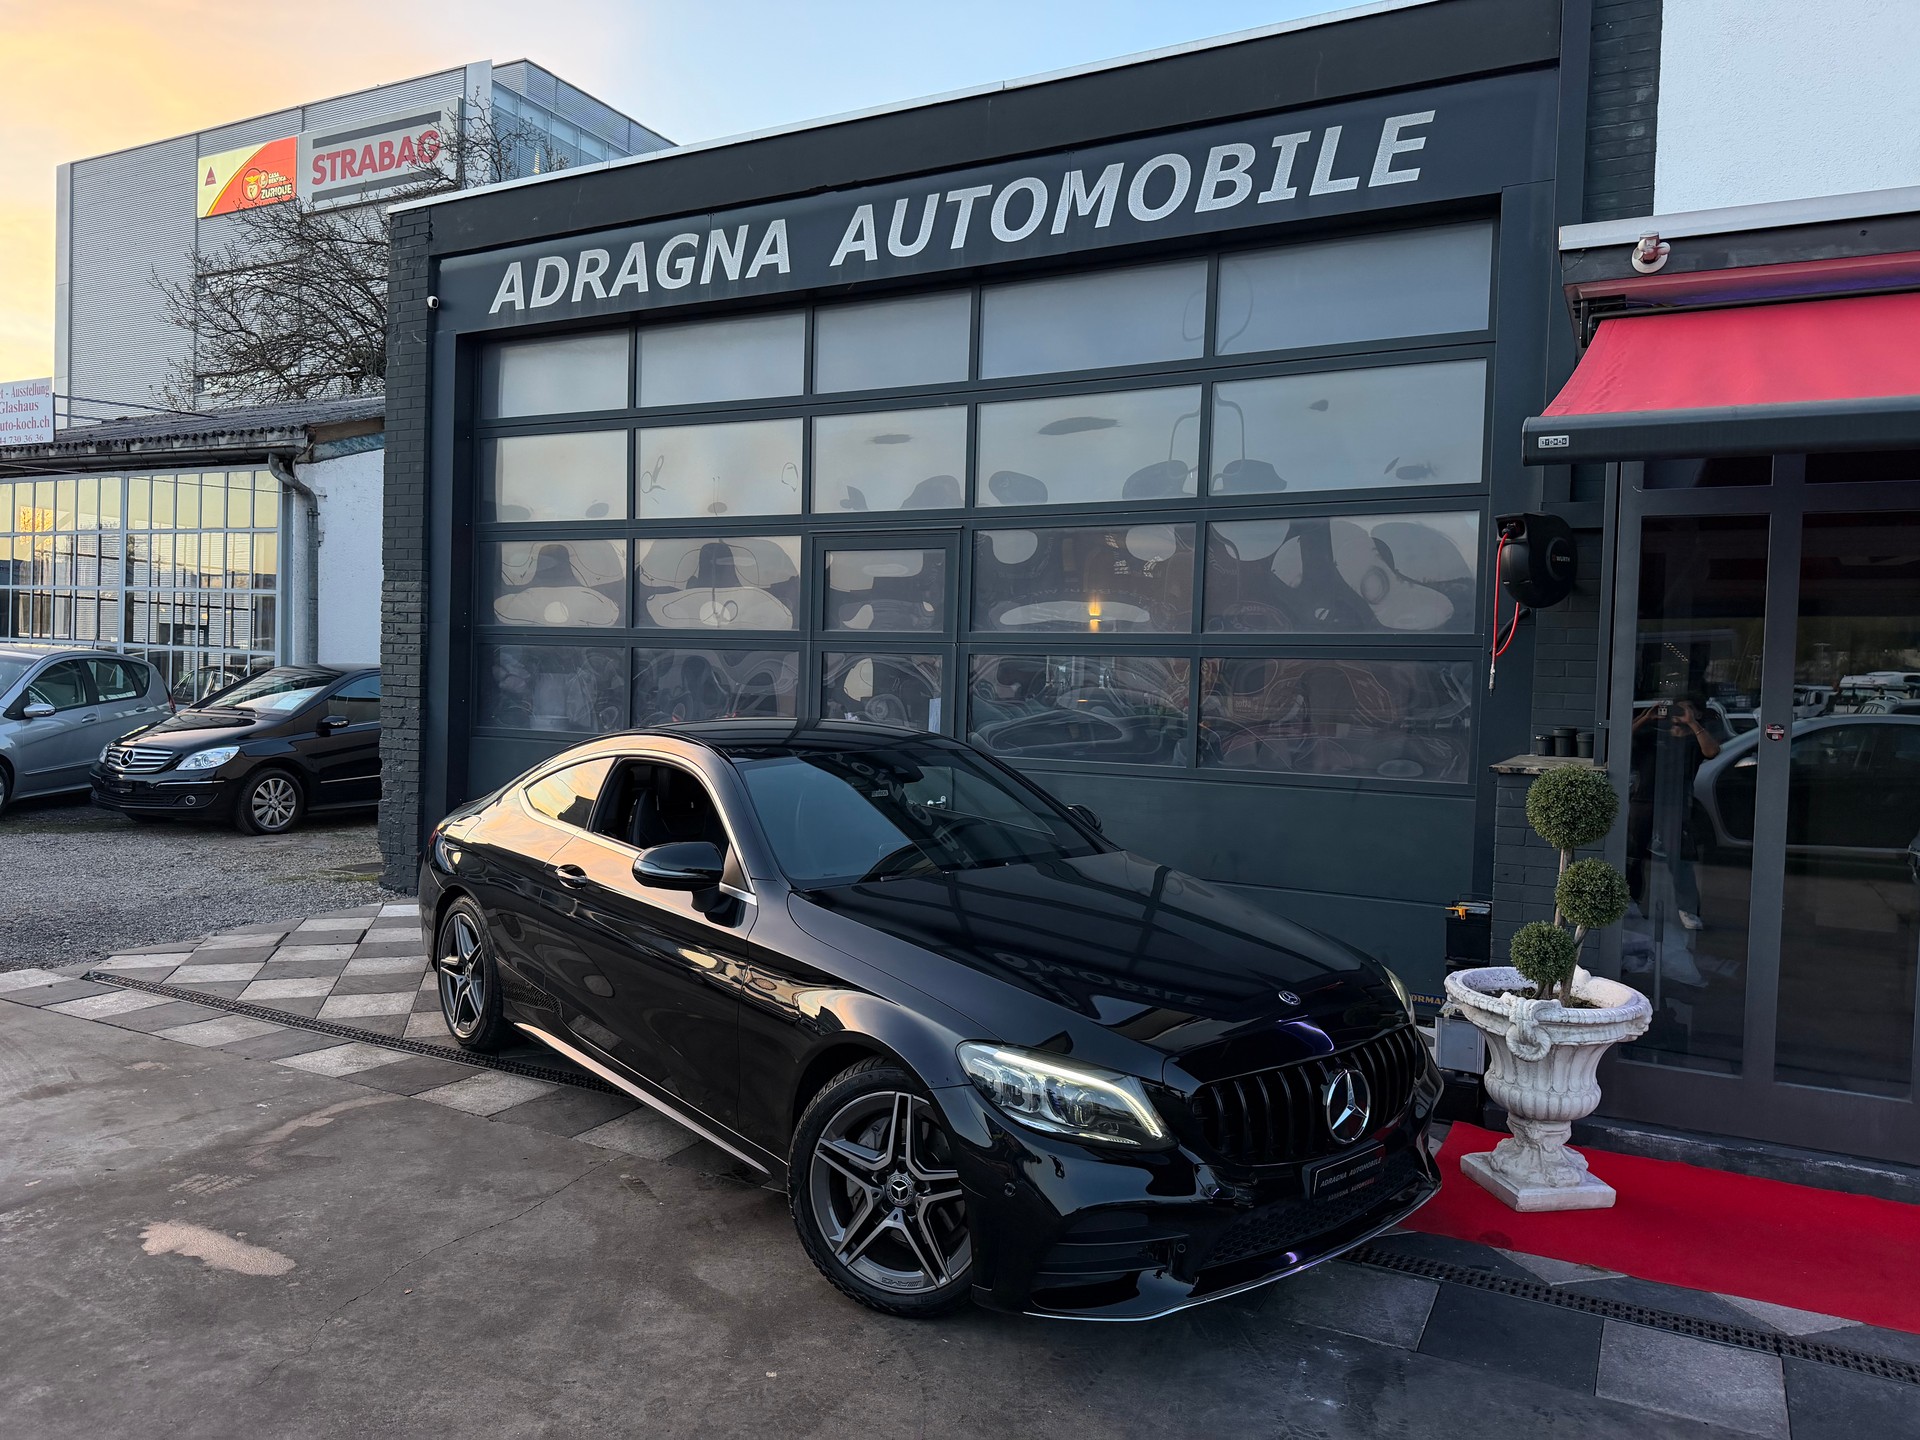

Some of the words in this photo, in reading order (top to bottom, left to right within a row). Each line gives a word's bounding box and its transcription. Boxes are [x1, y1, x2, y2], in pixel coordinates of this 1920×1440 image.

[311, 130, 440, 186] STRABAG
[261, 184, 292, 199] ZURIQUE
[489, 218, 792, 314] ADRAGNA
[829, 110, 1436, 266] AUTOMOBILE
[11, 383, 50, 398] Ausstellung
[0, 400, 39, 414] Glashaus
[0, 415, 50, 431] uto-koch.ch
[1320, 1171, 1347, 1188] ADRAGNA
[1349, 1157, 1383, 1177] AUTOMOBILE
